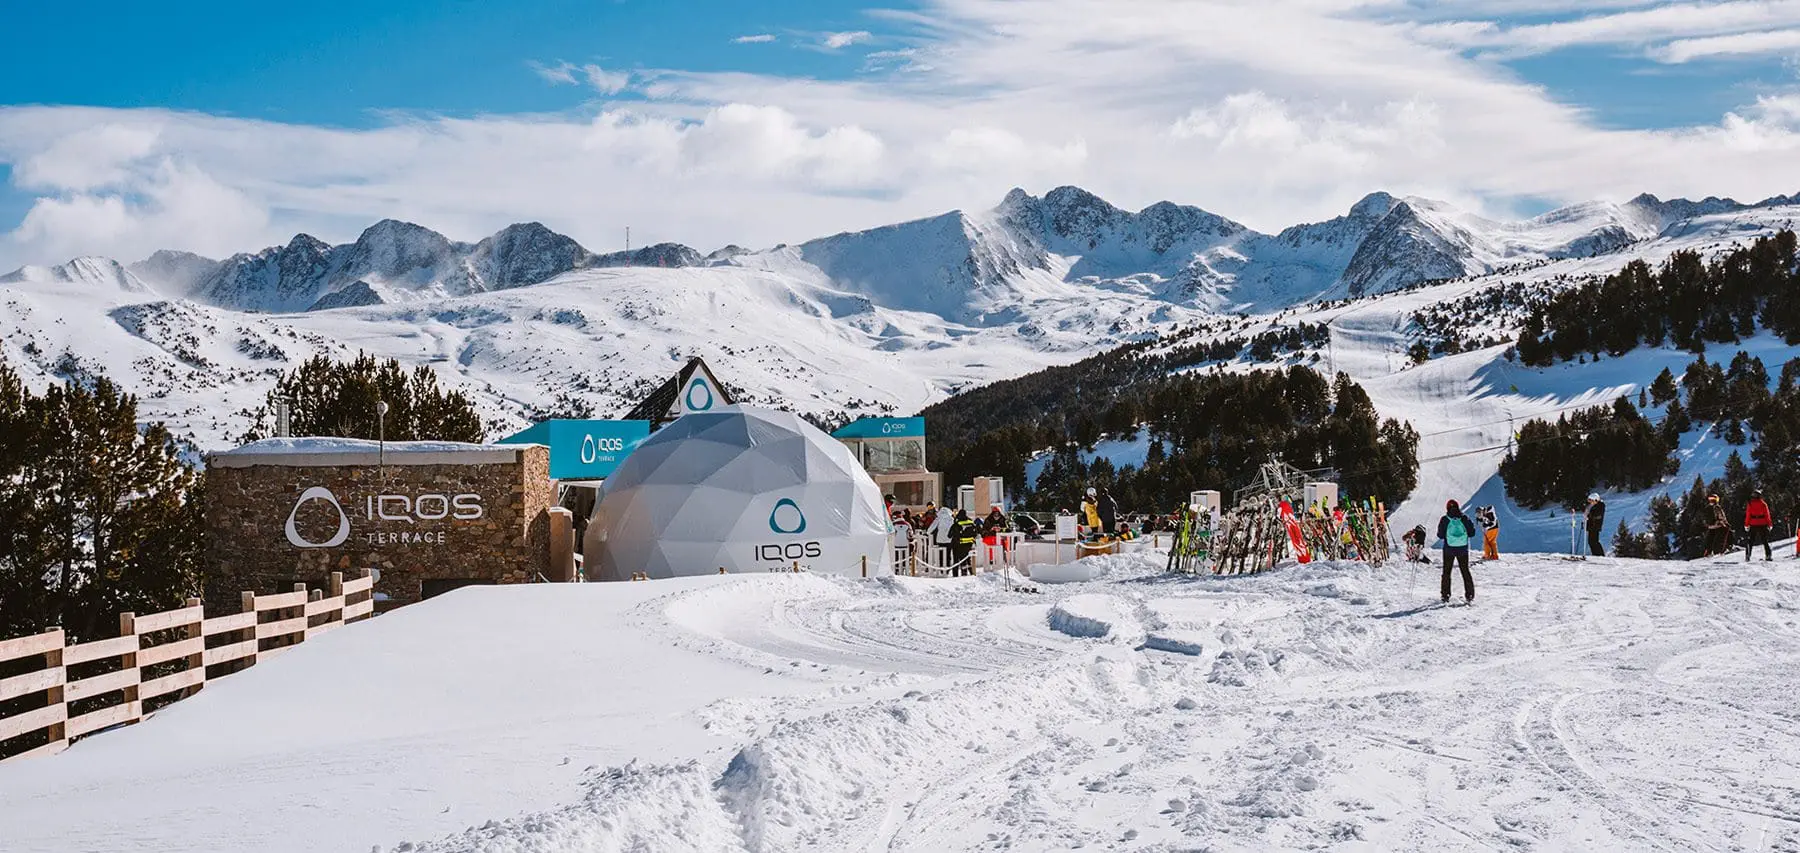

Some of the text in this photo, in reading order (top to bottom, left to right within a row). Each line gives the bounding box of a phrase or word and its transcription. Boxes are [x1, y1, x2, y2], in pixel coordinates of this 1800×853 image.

[598, 438, 623, 452] IQOS
[367, 493, 483, 524] IQOS
[367, 531, 446, 544] TERRACE
[755, 541, 821, 562] IQOS
